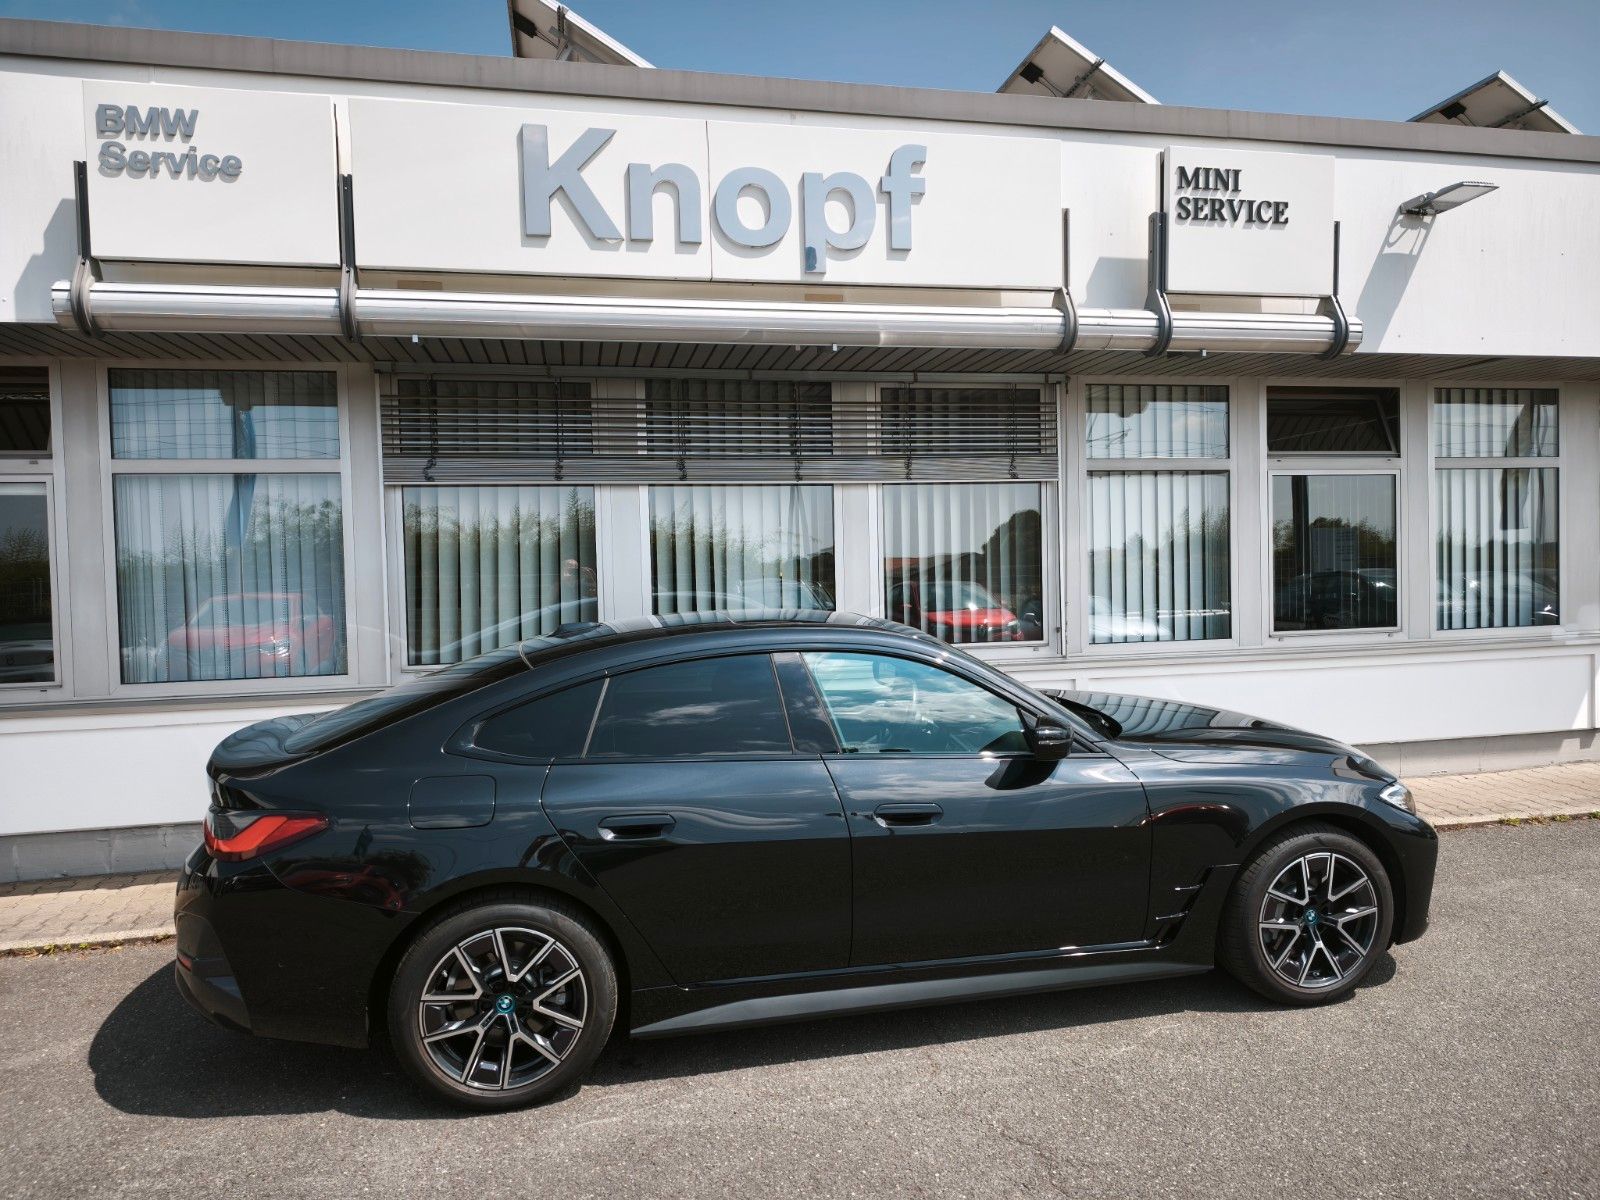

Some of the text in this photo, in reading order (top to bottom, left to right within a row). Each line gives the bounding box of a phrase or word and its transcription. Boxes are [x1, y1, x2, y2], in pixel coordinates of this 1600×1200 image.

[95, 103, 199, 138] BMW
[99, 140, 243, 179] Service
[1176, 165, 1242, 192] MINI
[518, 123, 928, 274] Knopf
[1176, 196, 1289, 226] SERVICE
